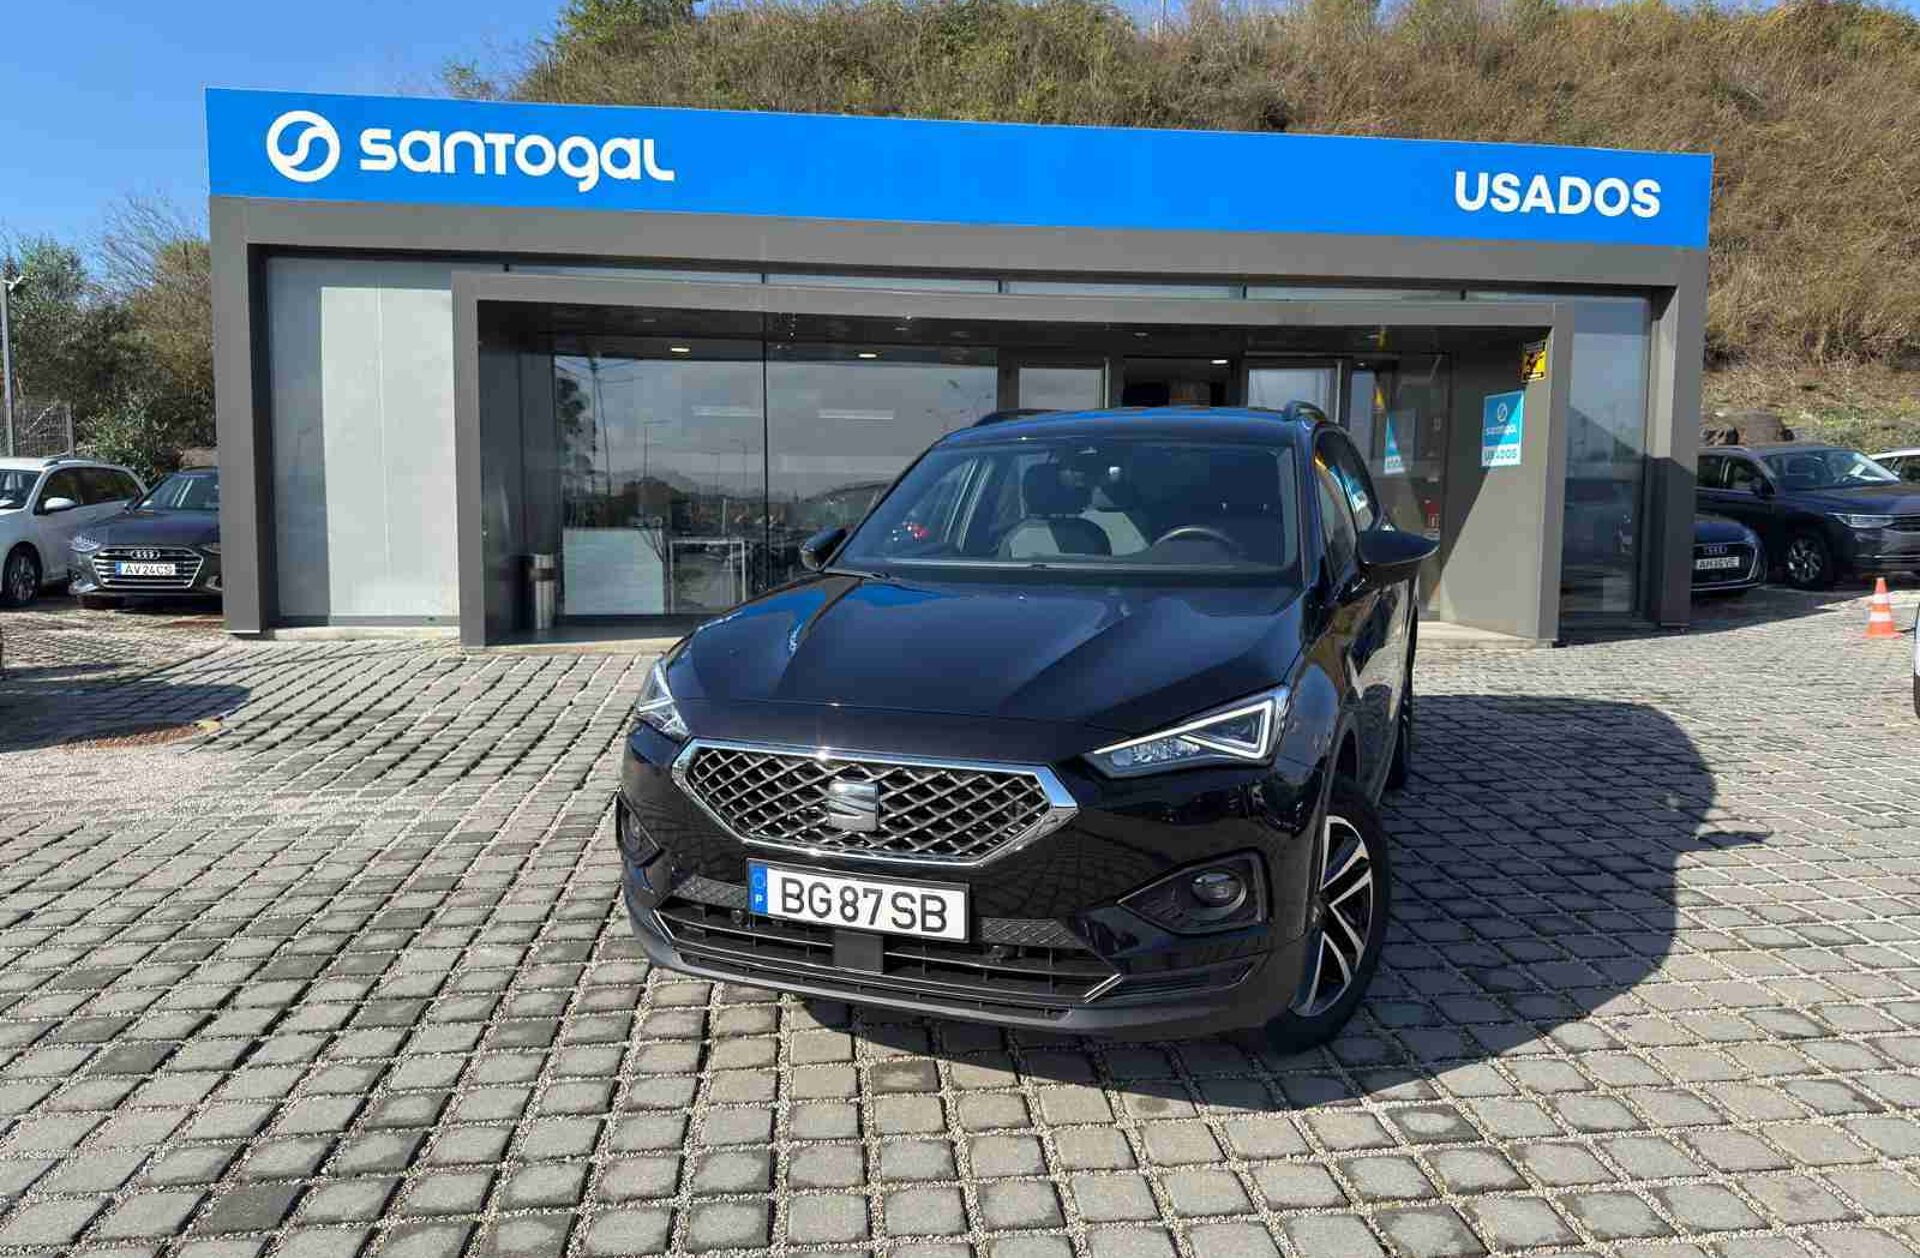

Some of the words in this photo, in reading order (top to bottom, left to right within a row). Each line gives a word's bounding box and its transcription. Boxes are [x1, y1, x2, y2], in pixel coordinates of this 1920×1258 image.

[1455, 170, 1662, 218] USADOS
[781, 876, 832, 919] BG
[839, 885, 883, 926] 87
[890, 891, 948, 933] SB
